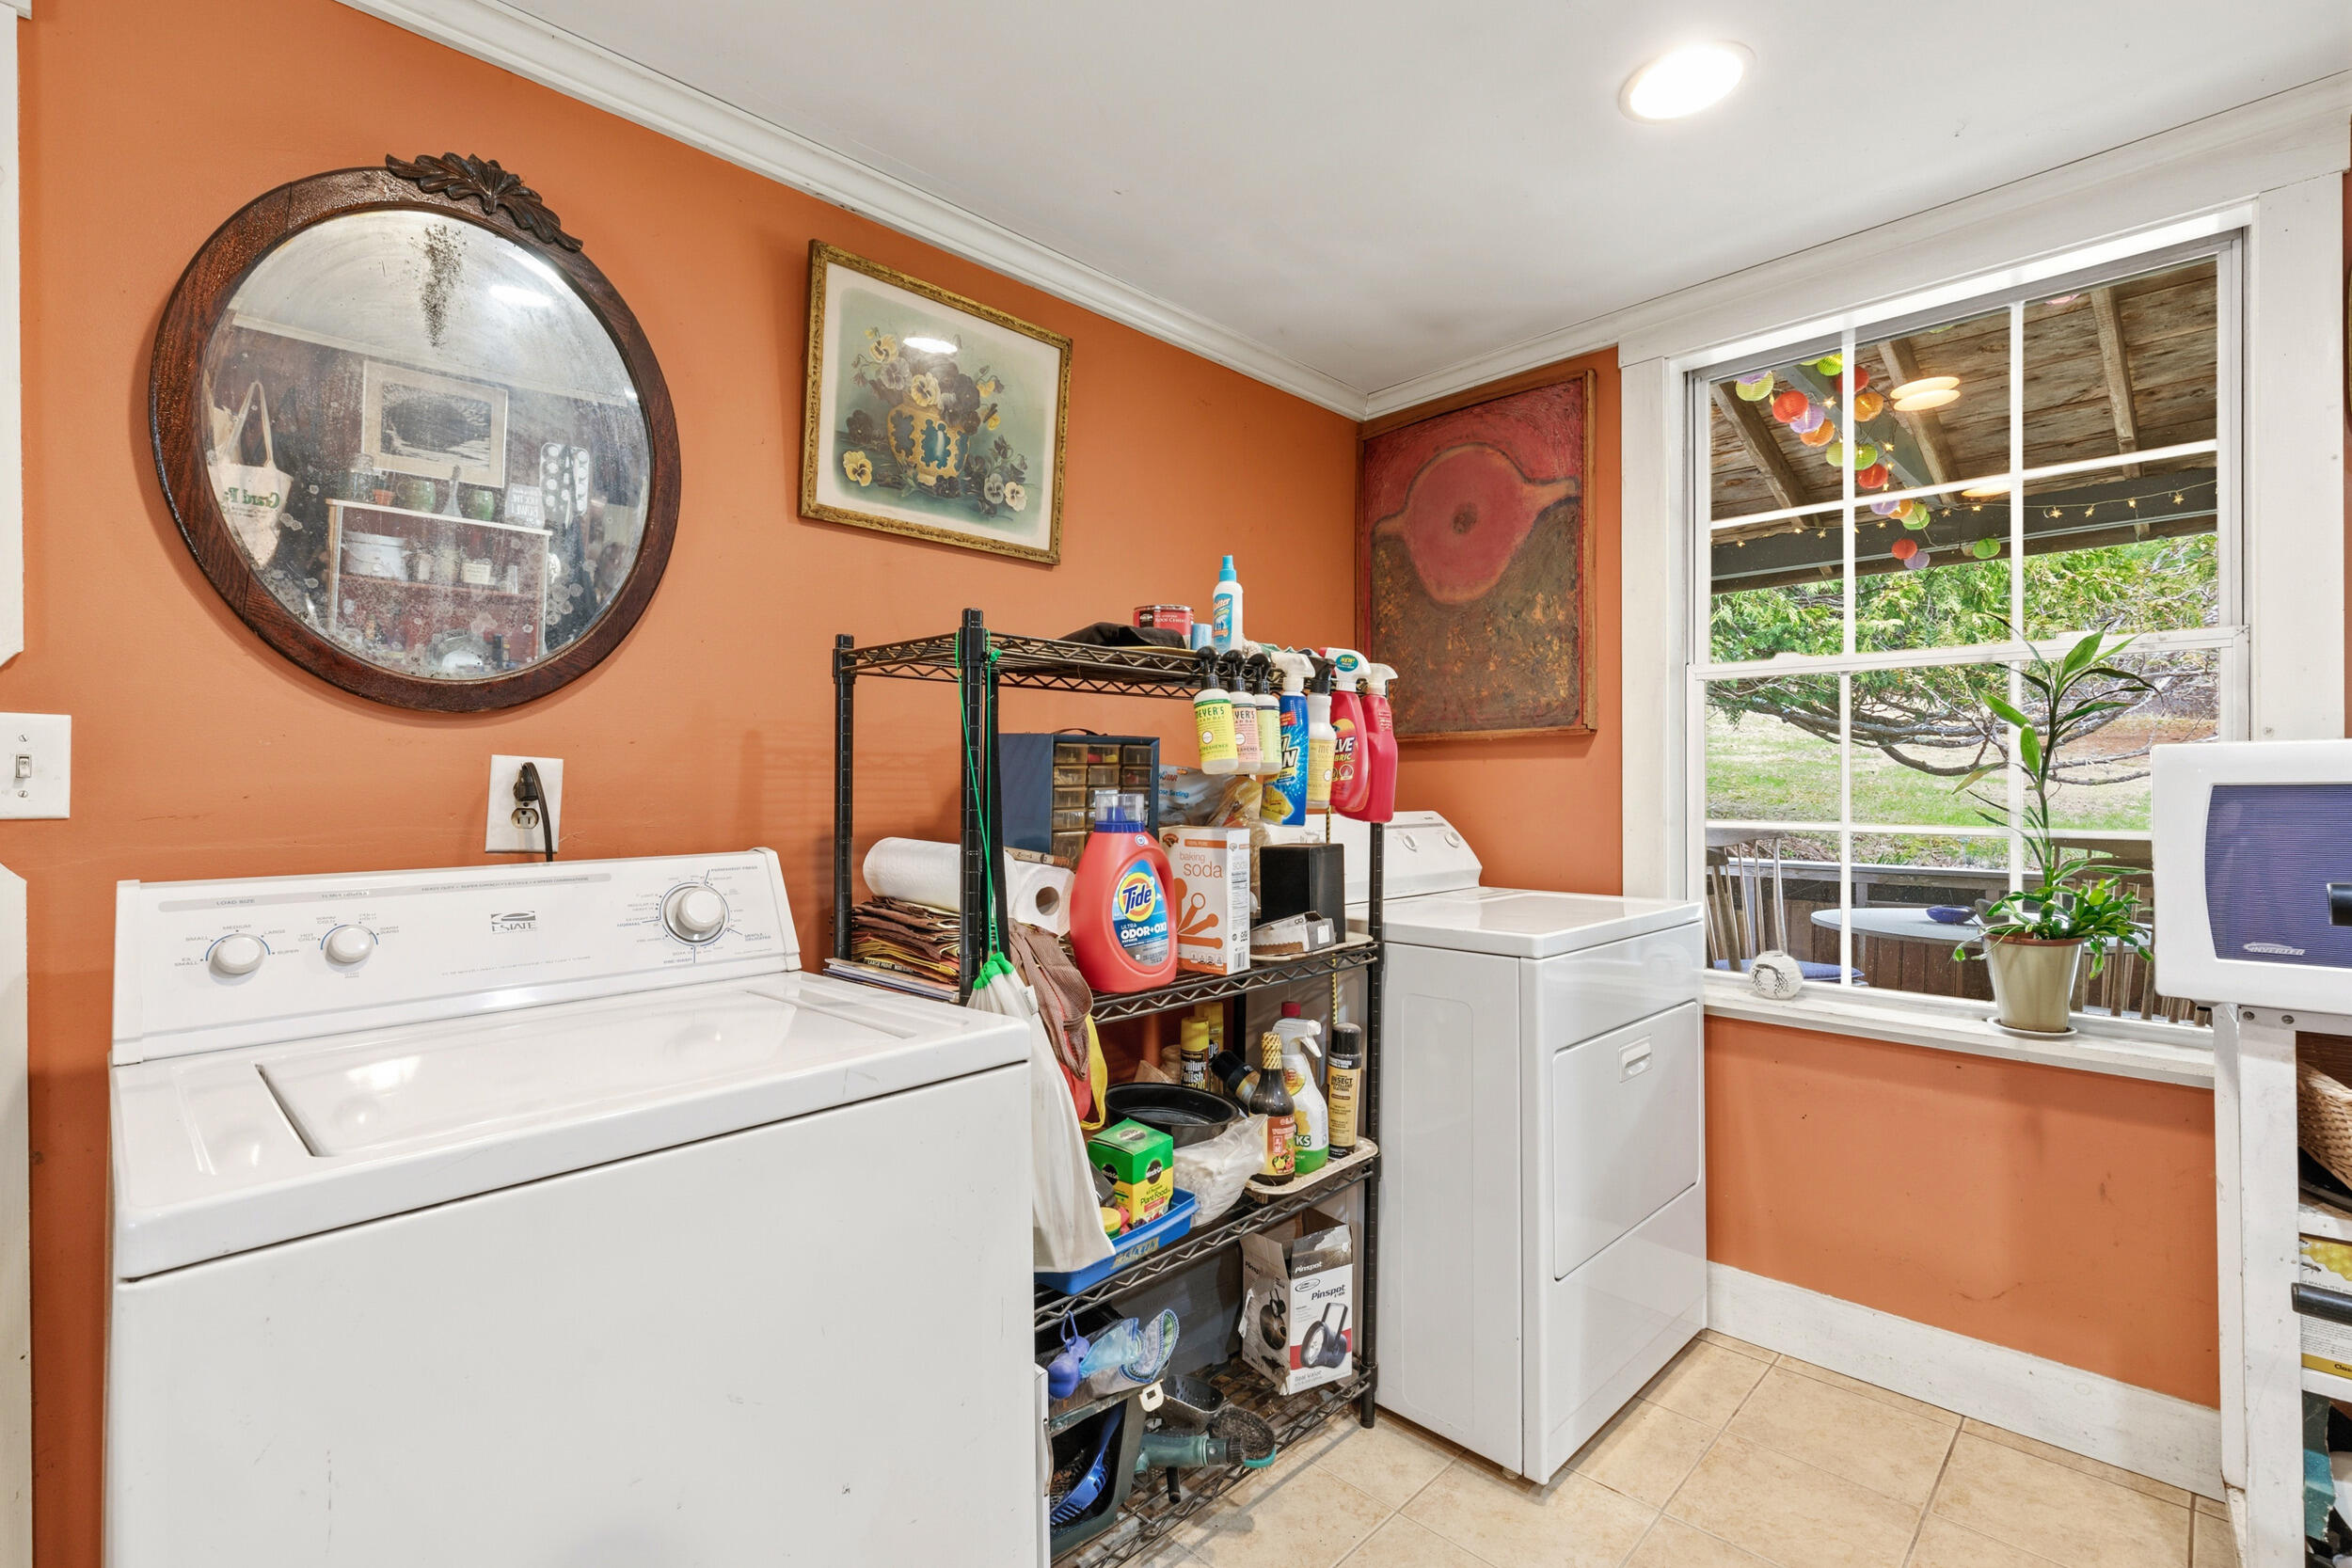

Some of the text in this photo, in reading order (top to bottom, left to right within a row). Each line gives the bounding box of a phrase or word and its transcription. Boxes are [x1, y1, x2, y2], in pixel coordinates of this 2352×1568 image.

[1179, 851, 1206, 863] baking
[1183, 862, 1223, 879] soda
[1122, 884, 1152, 916] Tide
[491, 922, 537, 932] ESTATE
[1331, 1075, 1353, 1085] INSECT
[1140, 1194, 1154, 1206] Plant
[1154, 1188, 1168, 1199] Food
[1295, 1260, 1323, 1275] Pinspot
[1311, 1284, 1346, 1300] Pinspot
